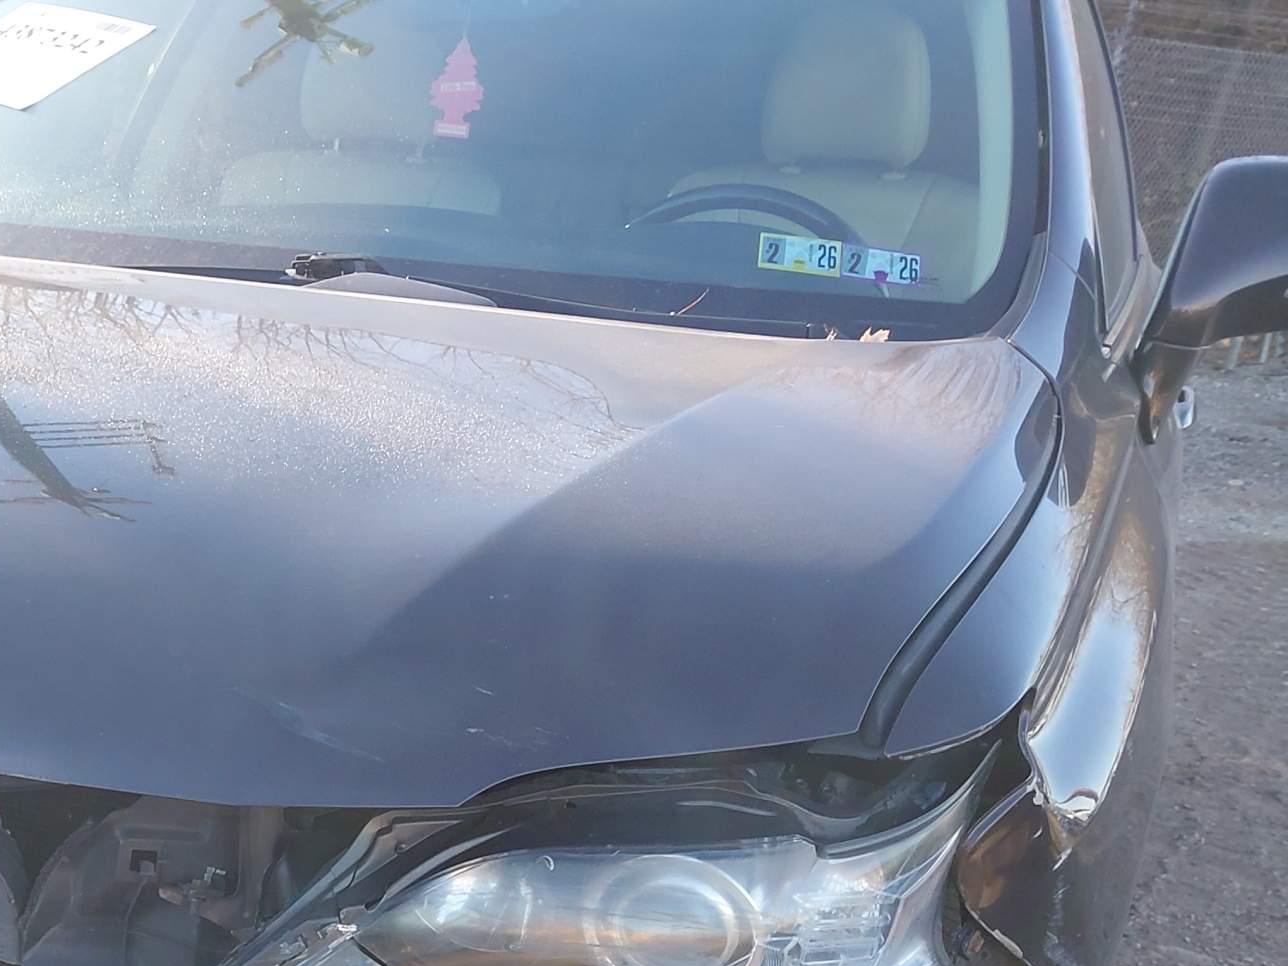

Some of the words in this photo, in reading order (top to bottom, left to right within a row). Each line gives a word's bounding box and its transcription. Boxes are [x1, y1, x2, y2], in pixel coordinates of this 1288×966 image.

[767, 242, 780, 264] 2
[817, 243, 837, 269] 26
[848, 252, 862, 274] 2
[899, 256, 918, 282] 26
